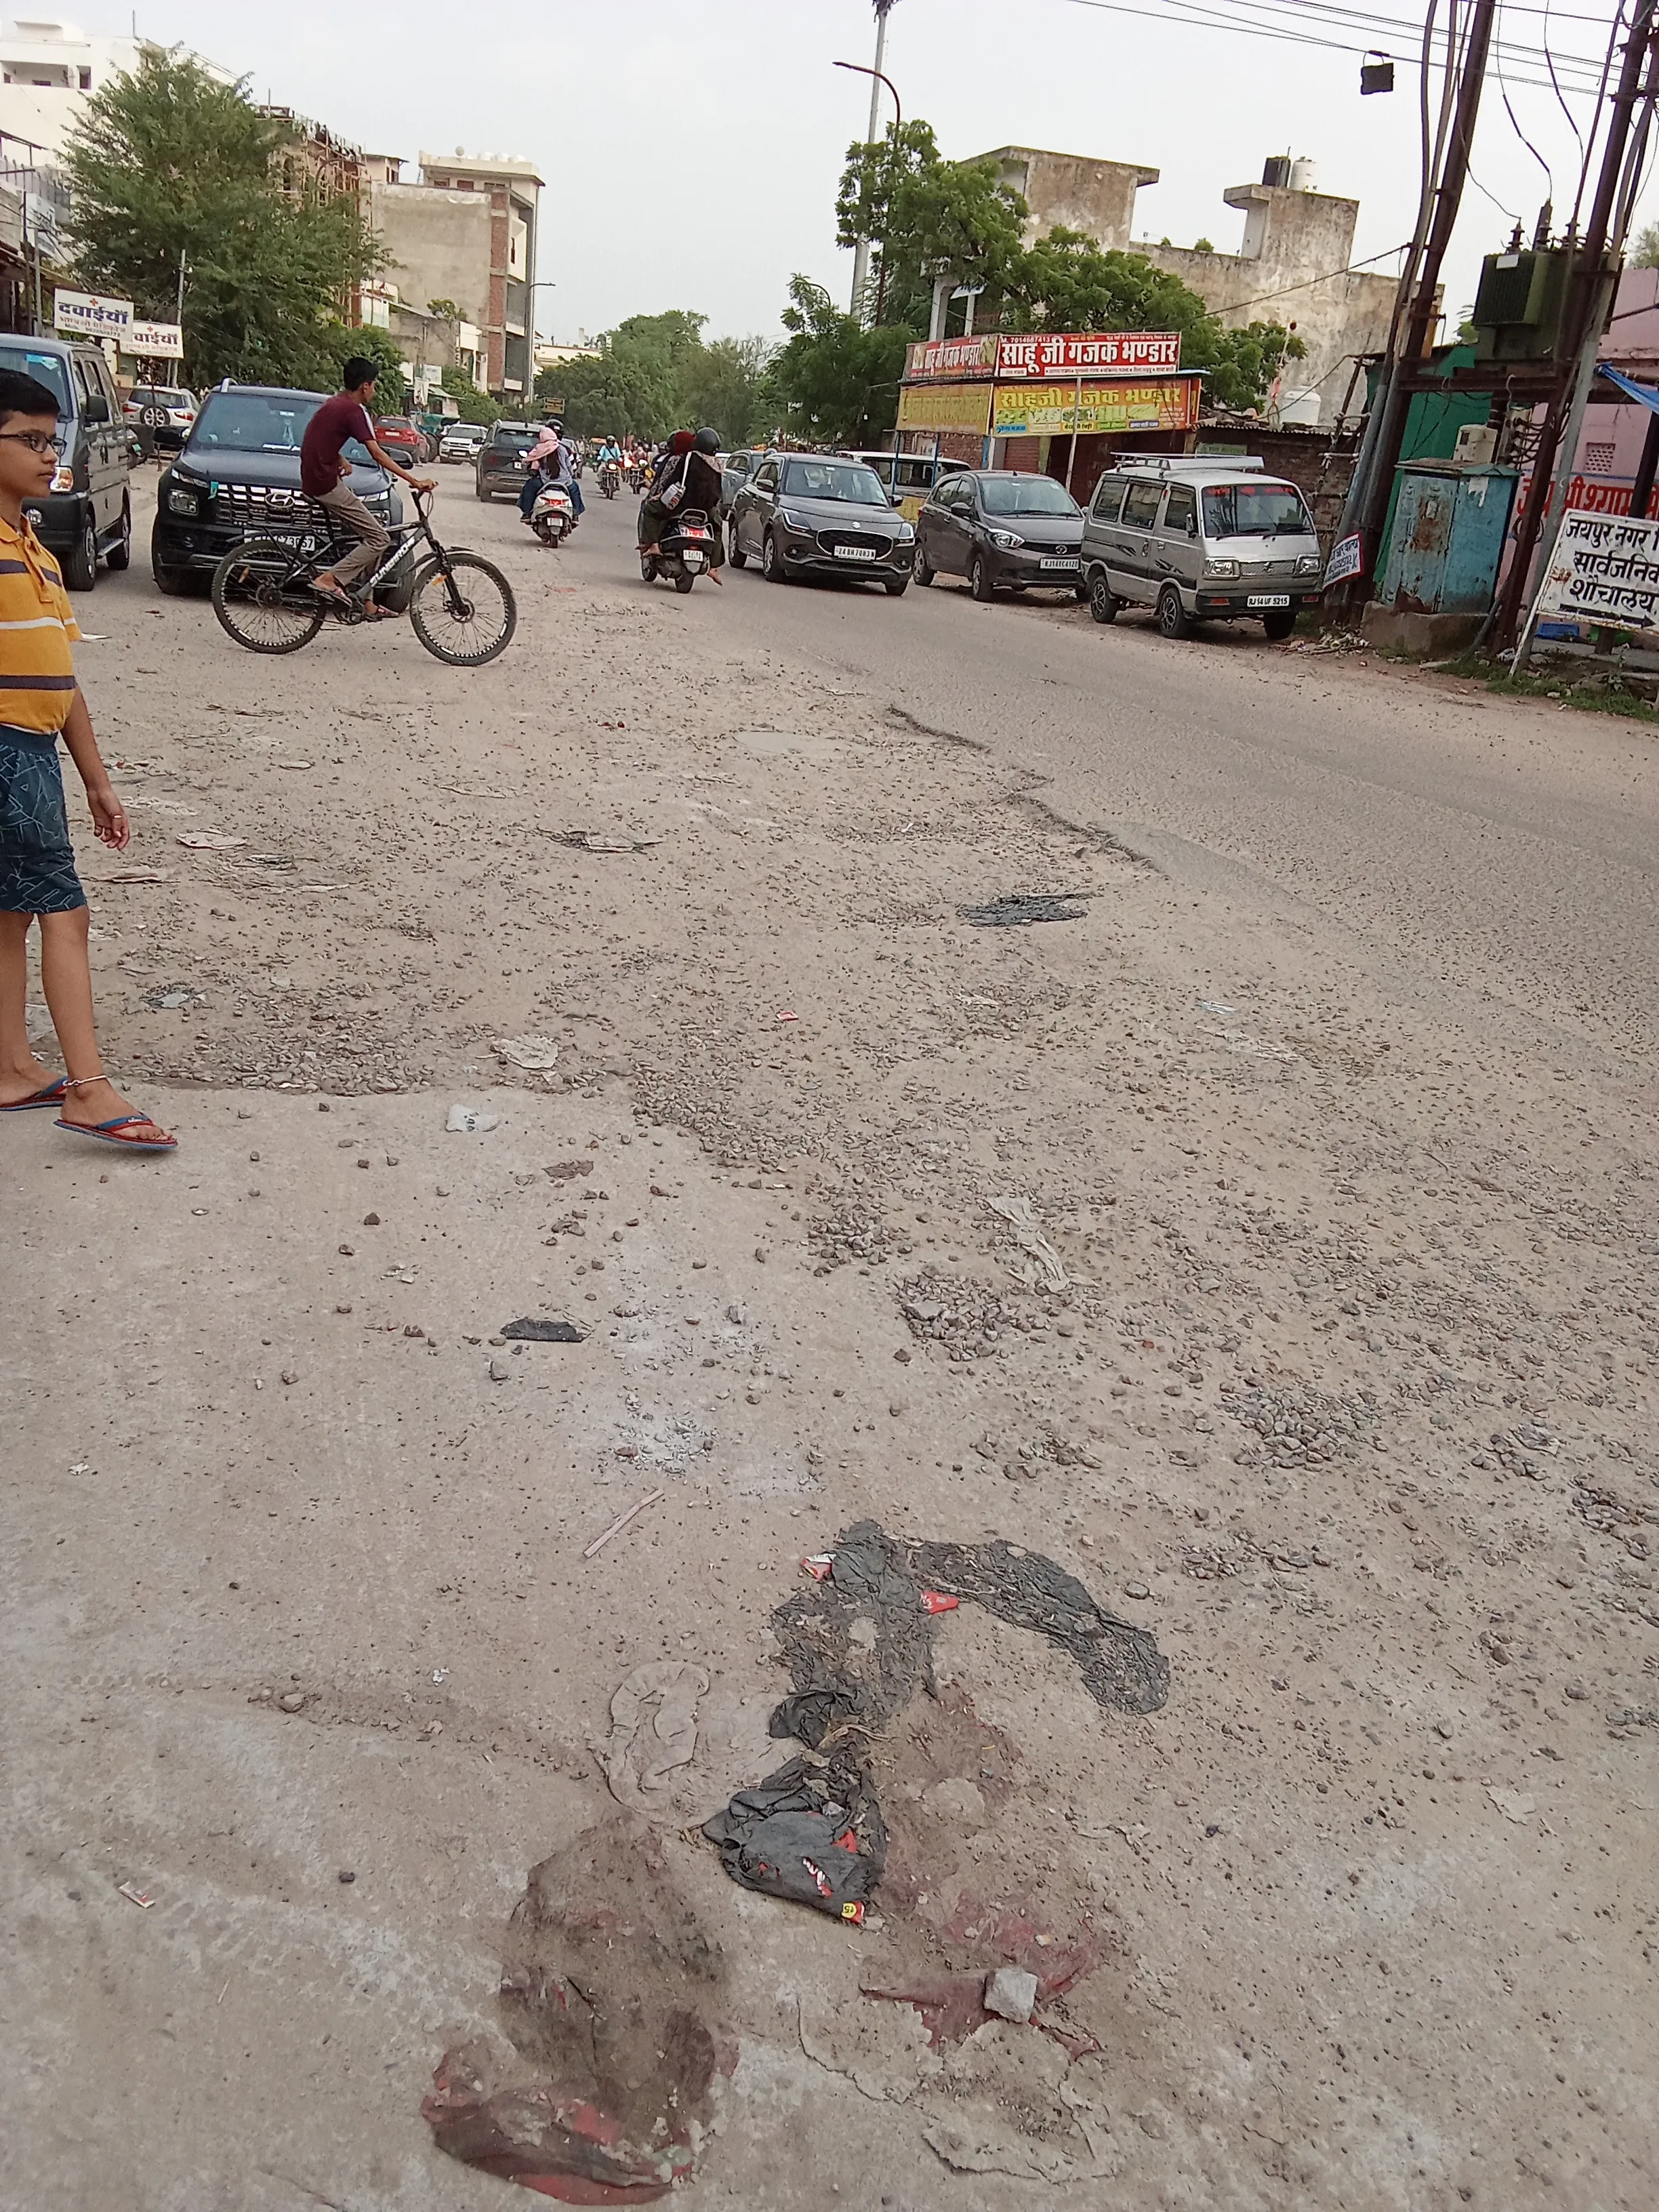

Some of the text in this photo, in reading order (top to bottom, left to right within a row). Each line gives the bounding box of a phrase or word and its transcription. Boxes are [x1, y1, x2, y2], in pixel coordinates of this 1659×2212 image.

[1002, 336, 1177, 373] साहू जी गजक भण्डार
[1068, 389, 1119, 405] गजक
[1566, 518, 1615, 548] जयपुर
[1616, 525, 1651, 552] नगर
